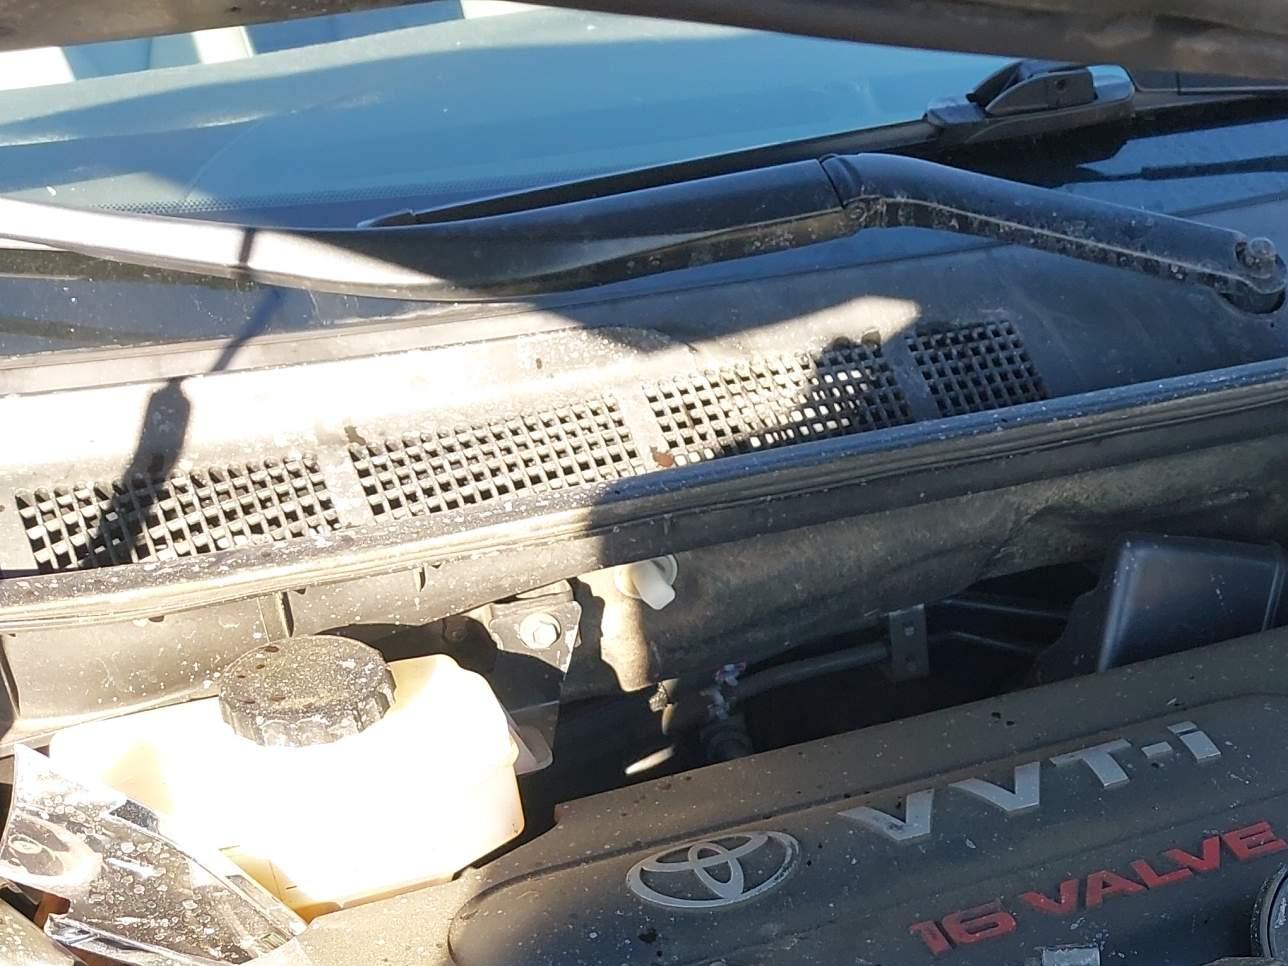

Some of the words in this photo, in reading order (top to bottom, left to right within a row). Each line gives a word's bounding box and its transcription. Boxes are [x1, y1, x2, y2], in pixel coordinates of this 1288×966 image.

[838, 719, 1222, 841] VVT-i
[910, 900, 1017, 957] 16
[1019, 819, 1288, 916] VALVE
